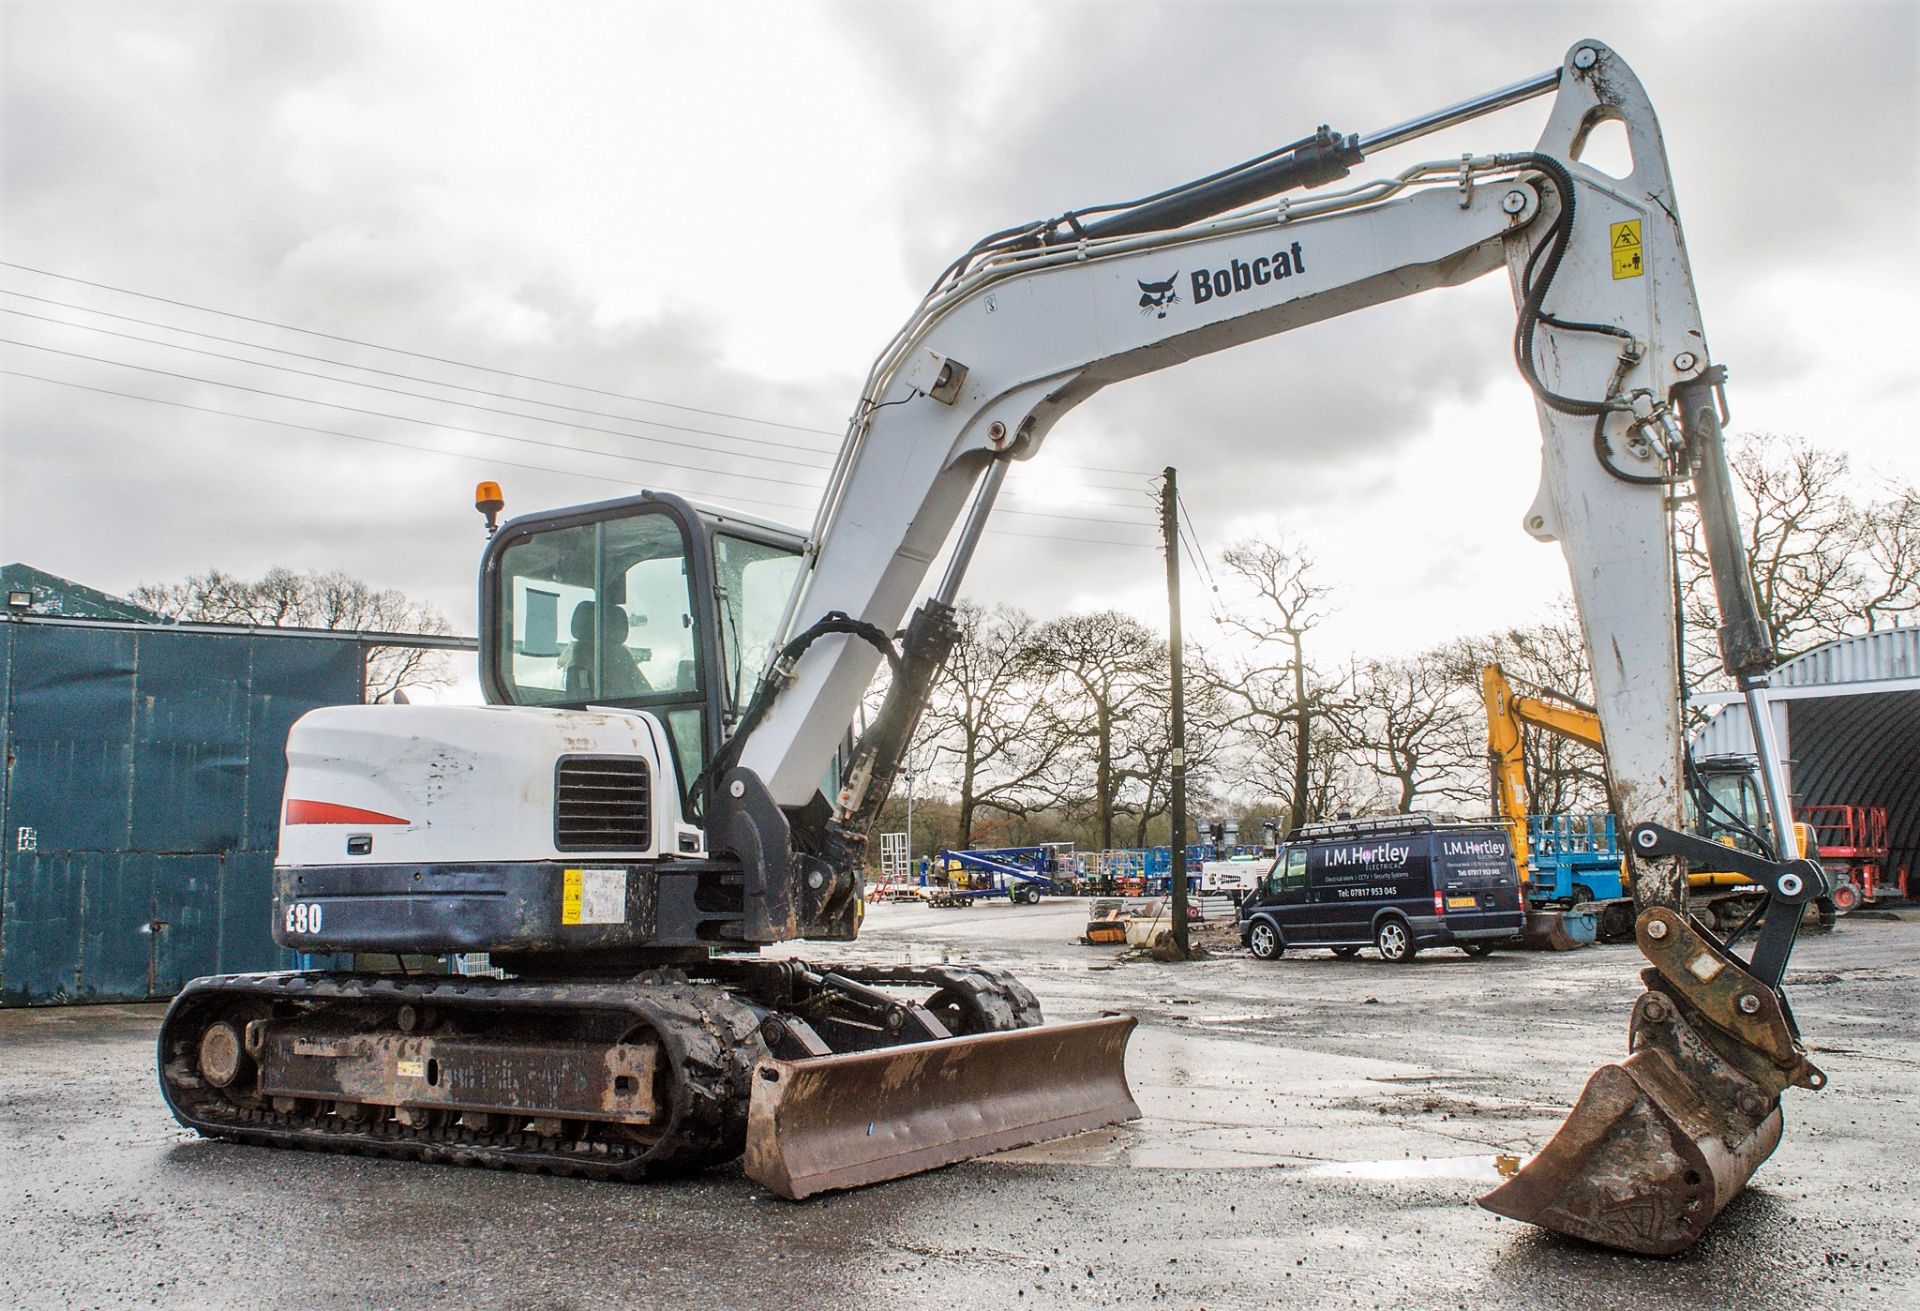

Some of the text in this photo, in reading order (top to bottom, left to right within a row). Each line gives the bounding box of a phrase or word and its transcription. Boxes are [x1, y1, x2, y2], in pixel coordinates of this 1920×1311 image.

[1190, 241, 1305, 304] Bobcat
[1338, 886, 1397, 898] Tel: 07817 953 045
[285, 903, 322, 934] E80
